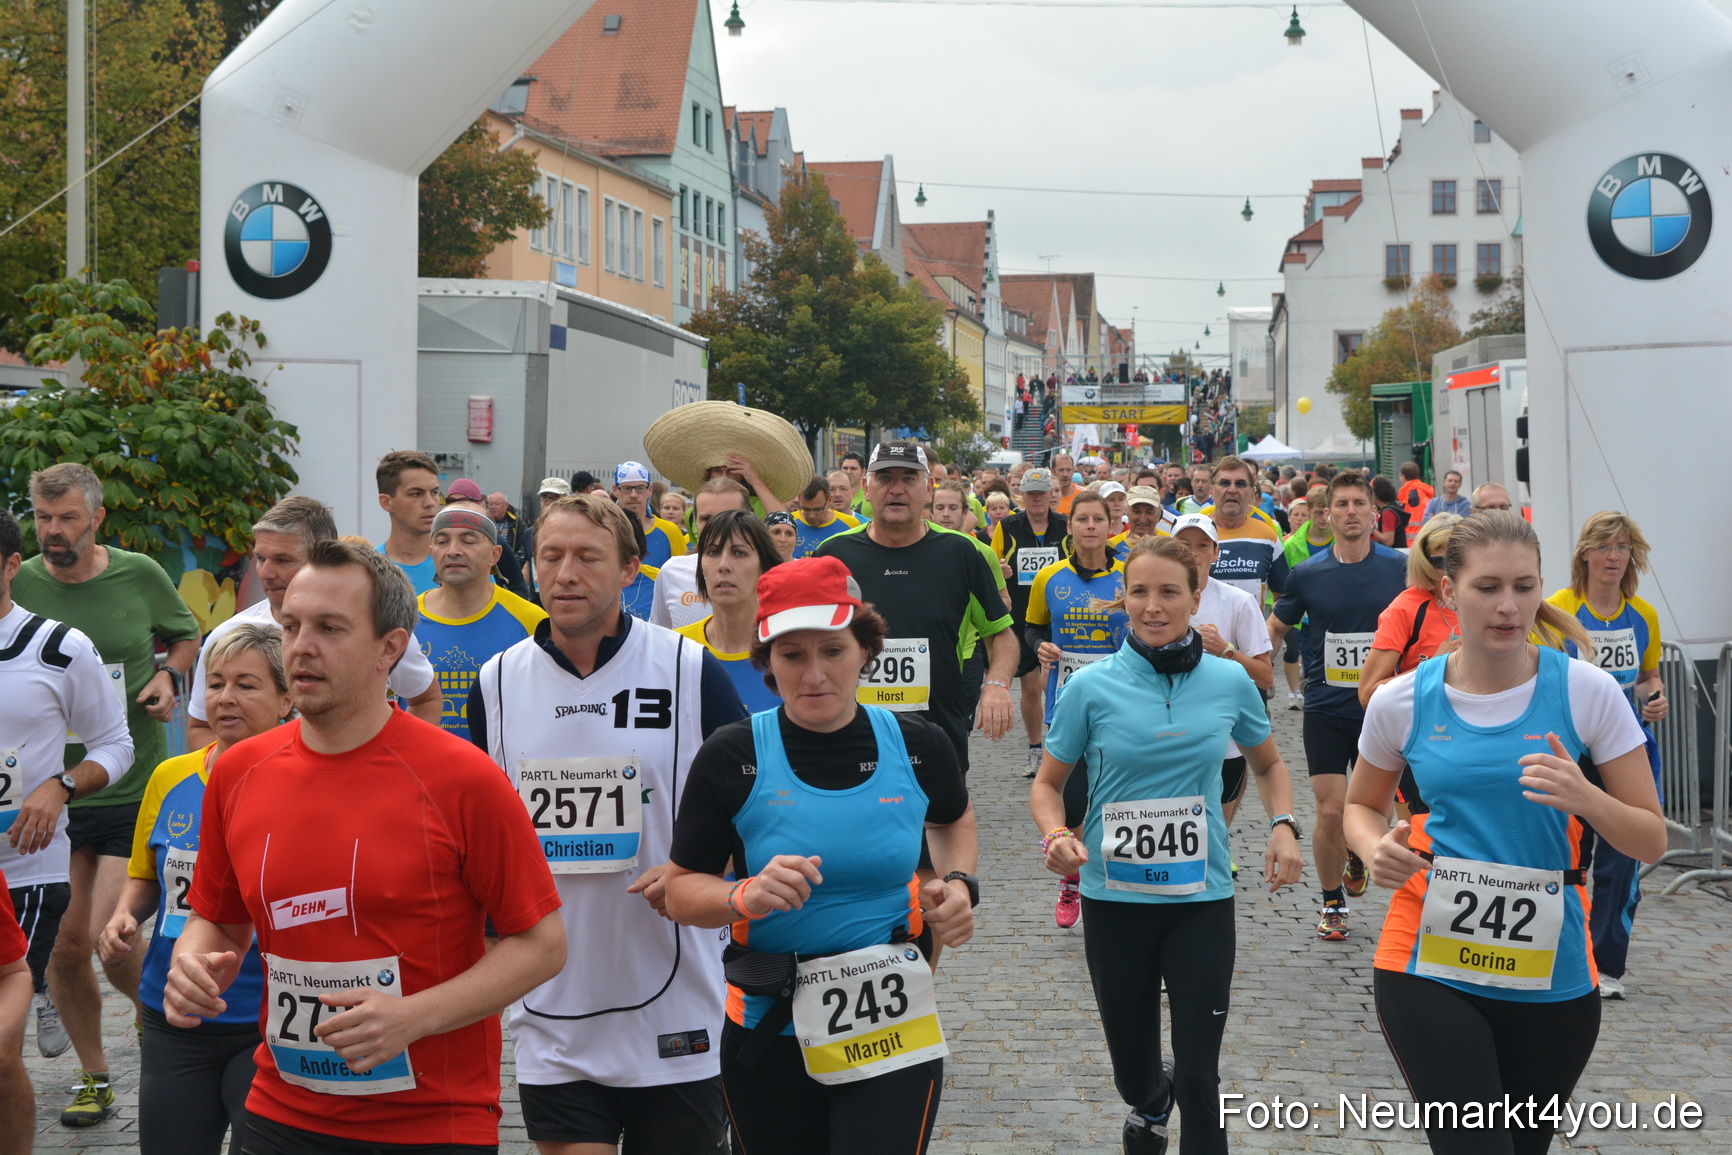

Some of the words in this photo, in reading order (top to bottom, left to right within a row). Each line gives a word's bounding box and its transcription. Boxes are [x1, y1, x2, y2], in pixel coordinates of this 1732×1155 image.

[1597, 155, 1703, 199] BMW
[231, 184, 324, 223] BMW
[1102, 409, 1145, 420] START
[1325, 637, 1345, 645] PARTL
[868, 656, 915, 683] 296
[1060, 656, 1077, 664] PARTL
[1341, 671, 1361, 680] Flori
[555, 703, 605, 719] SPALDING
[611, 687, 672, 729] 13
[877, 690, 904, 702] Horst
[521, 770, 557, 781] PARTL
[560, 769, 617, 780] Neumarkt
[0, 772, 12, 806] 2
[530, 785, 625, 829] 2571
[1104, 811, 1137, 822] PARTL
[1139, 808, 1188, 819] Neumarkt
[544, 840, 614, 857] Christian
[1114, 821, 1199, 859] 2646
[1145, 869, 1169, 881] Eva
[1434, 868, 1475, 884] PARTL
[1478, 874, 1541, 892] Neumarkt
[175, 876, 192, 911] 2
[291, 899, 327, 918] DEHN
[1450, 890, 1537, 943] 242
[797, 970, 837, 988] PARTL
[840, 954, 902, 978] Neumarkt
[1459, 947, 1516, 971] Corina
[269, 967, 301, 986] PARTL
[303, 975, 371, 989] Neumarkt
[822, 973, 908, 1036] 243
[844, 1031, 903, 1063] Margit
